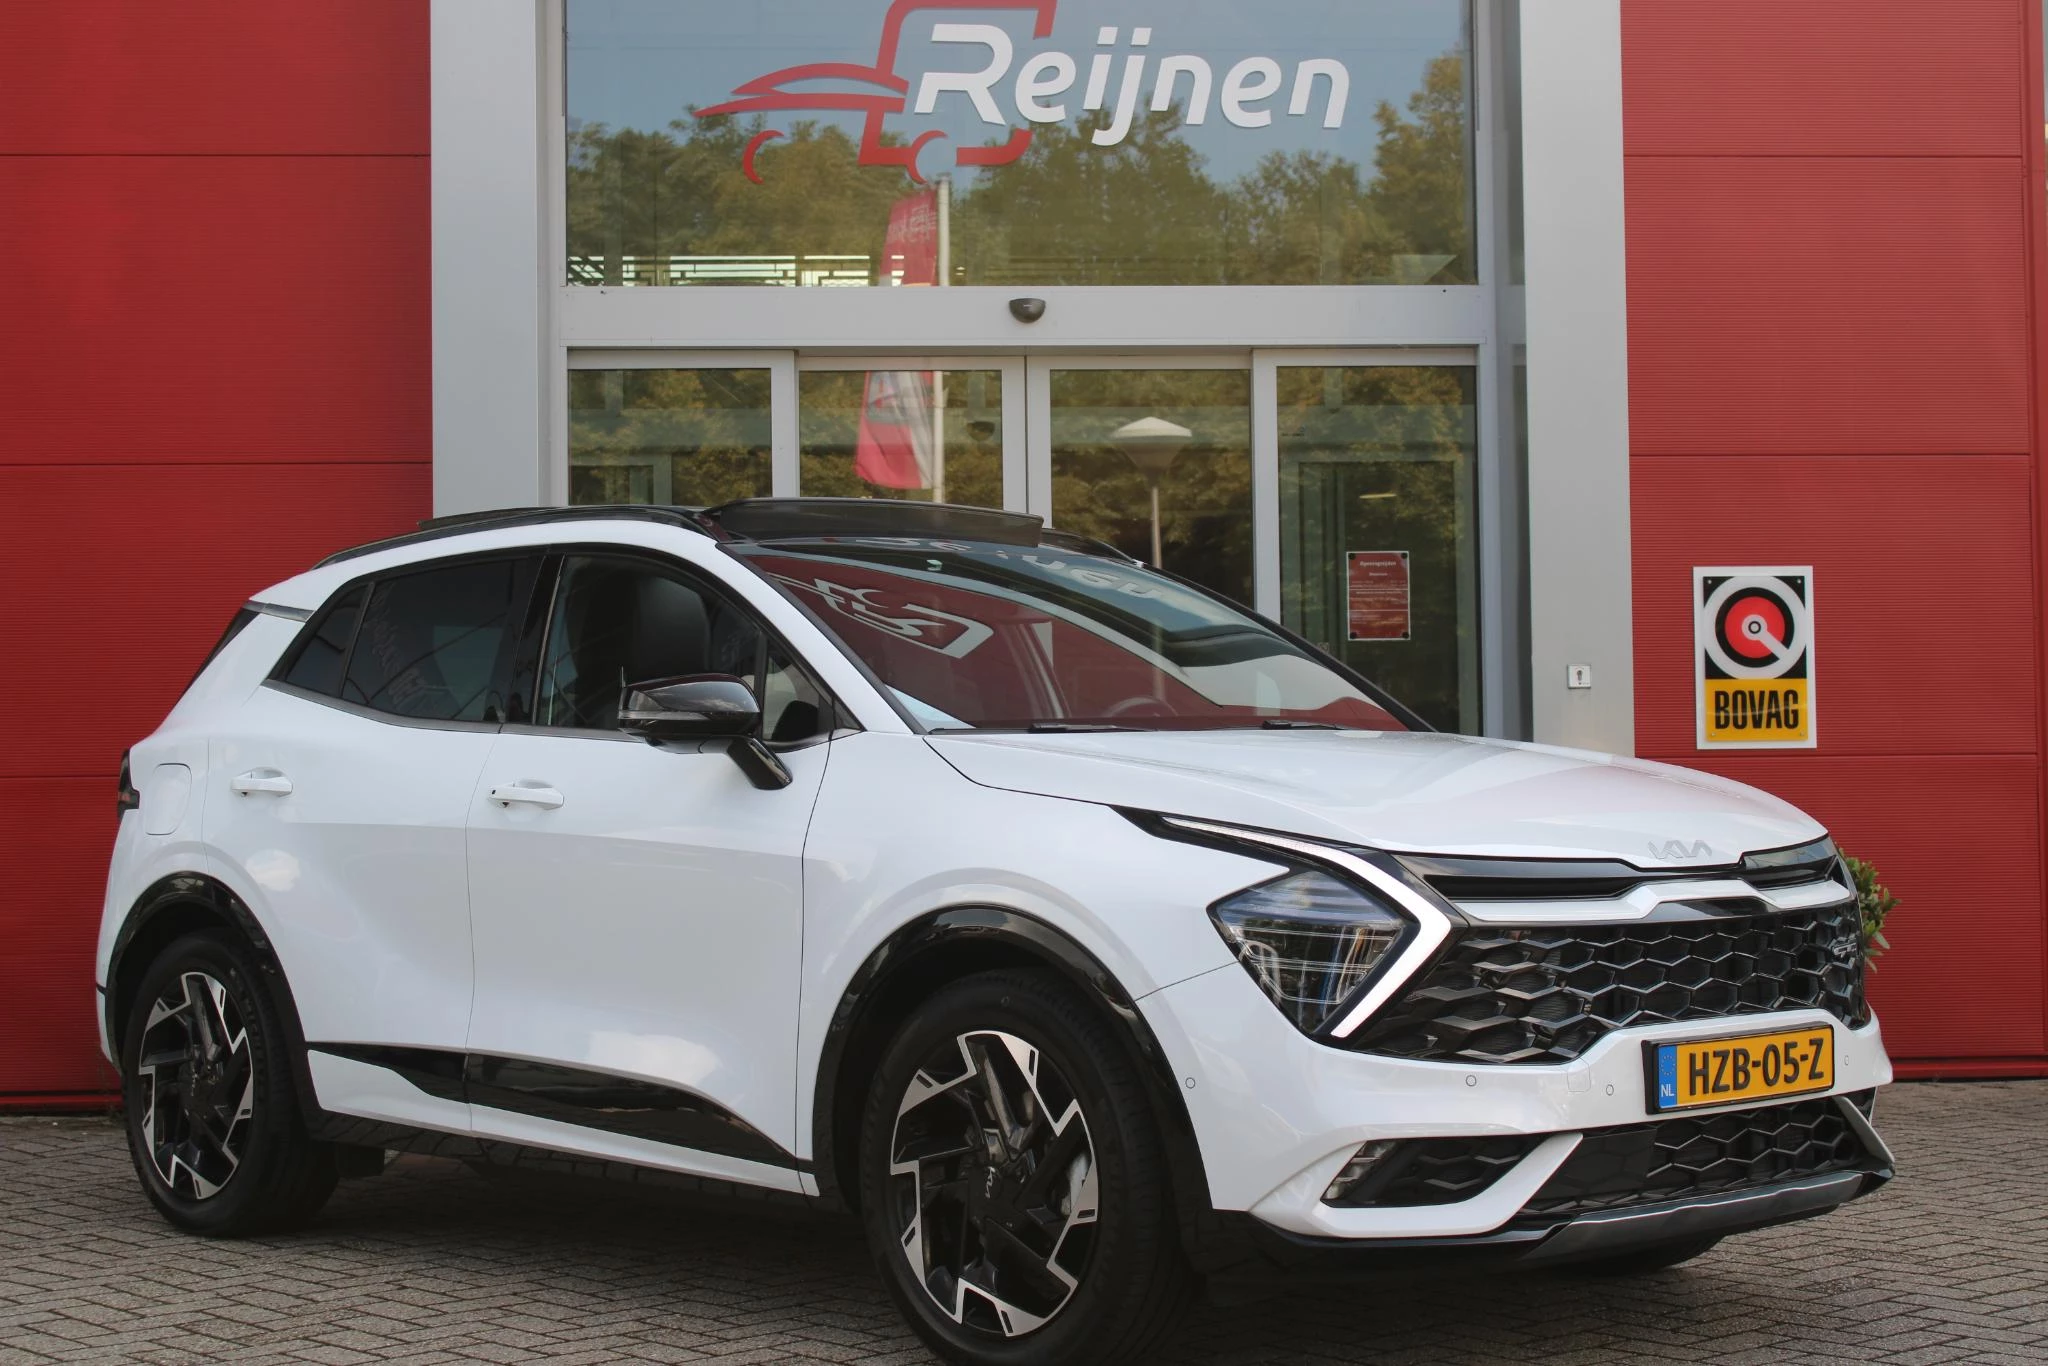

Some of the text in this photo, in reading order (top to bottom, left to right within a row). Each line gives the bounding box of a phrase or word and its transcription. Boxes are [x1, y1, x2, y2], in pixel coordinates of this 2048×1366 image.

[914, 23, 1350, 146] Reijnen
[1714, 689, 1799, 730] BOVAG
[1647, 839, 1713, 859] KIA
[1689, 1037, 1825, 1097] HZB-05-Z
[1660, 1084, 1675, 1097] NL
